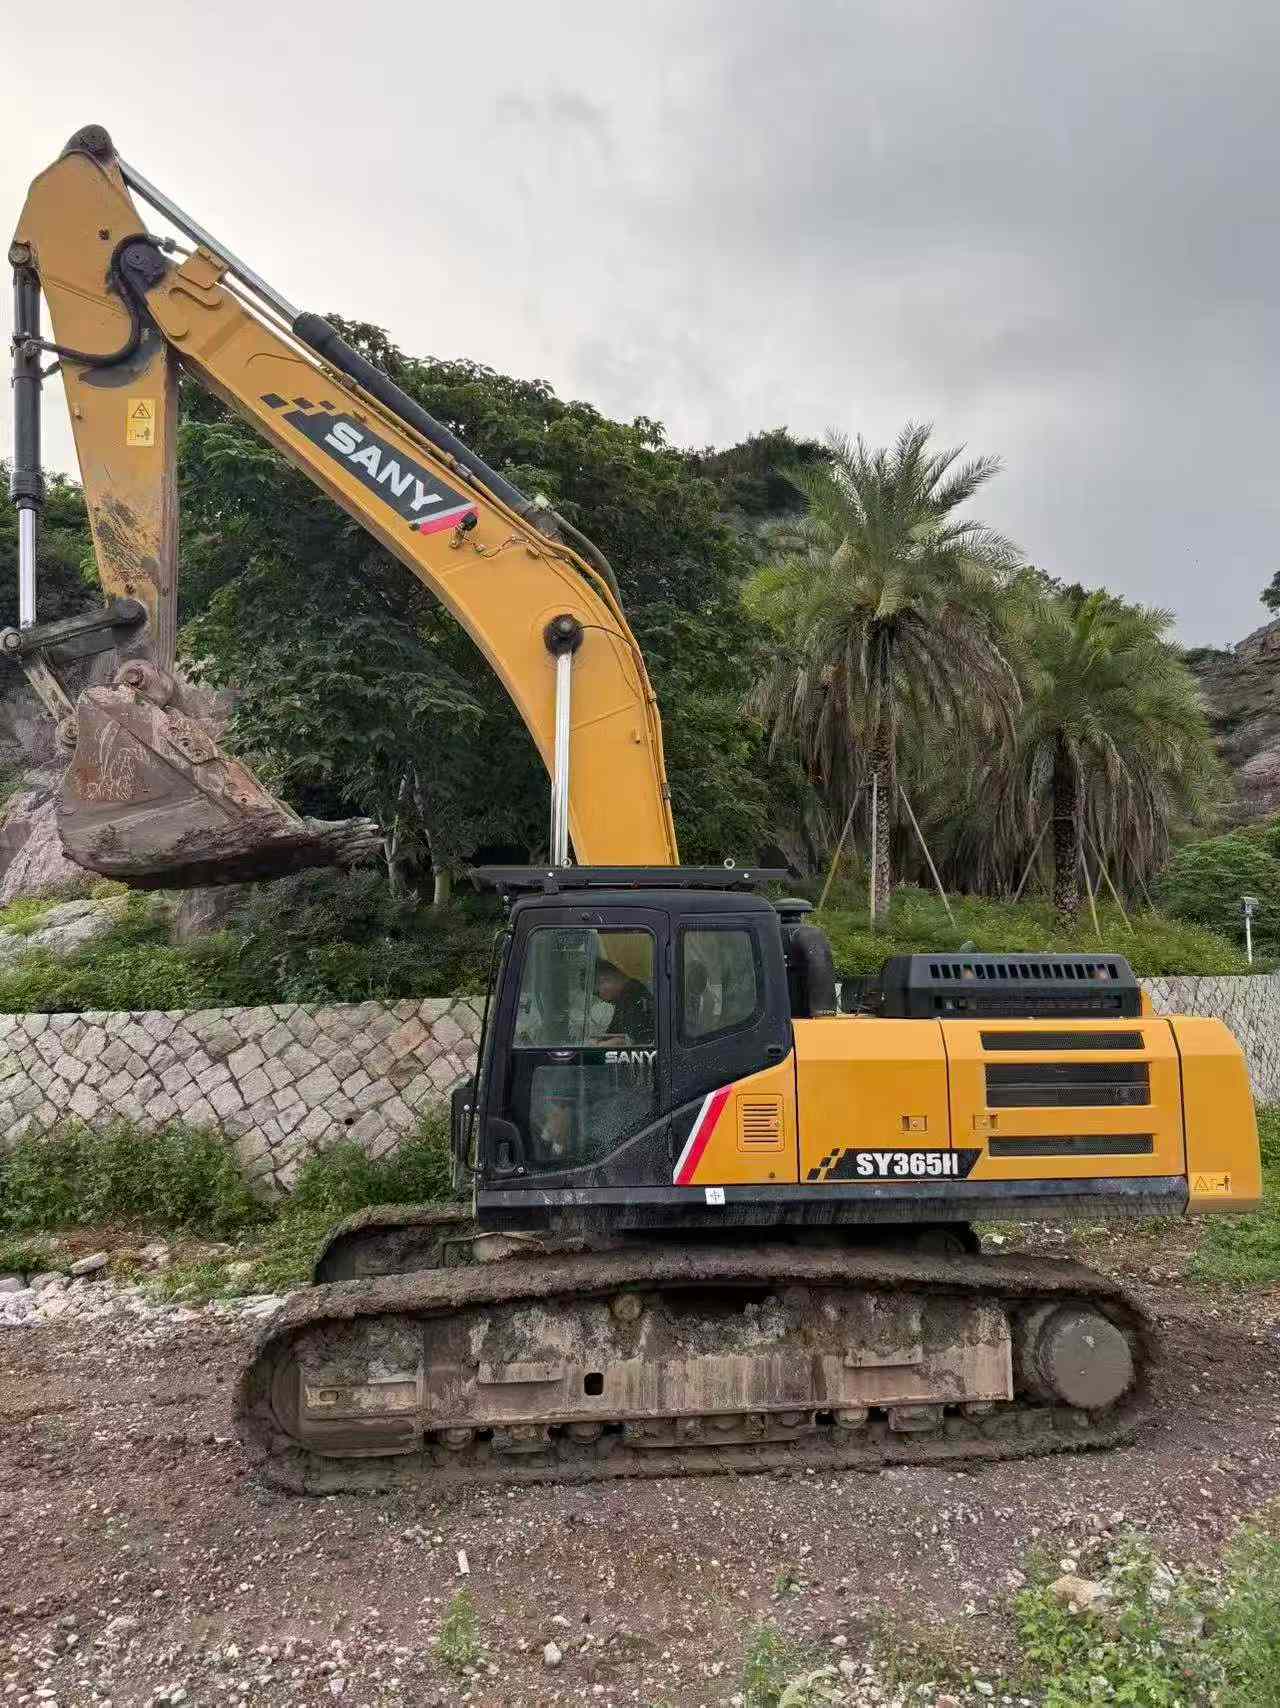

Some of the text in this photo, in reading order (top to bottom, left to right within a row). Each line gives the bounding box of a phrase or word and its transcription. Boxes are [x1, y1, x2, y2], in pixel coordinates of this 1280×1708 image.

[324, 422, 442, 511] SANY
[605, 1051, 657, 1064] SANY
[856, 1153, 958, 1176] SY365H
